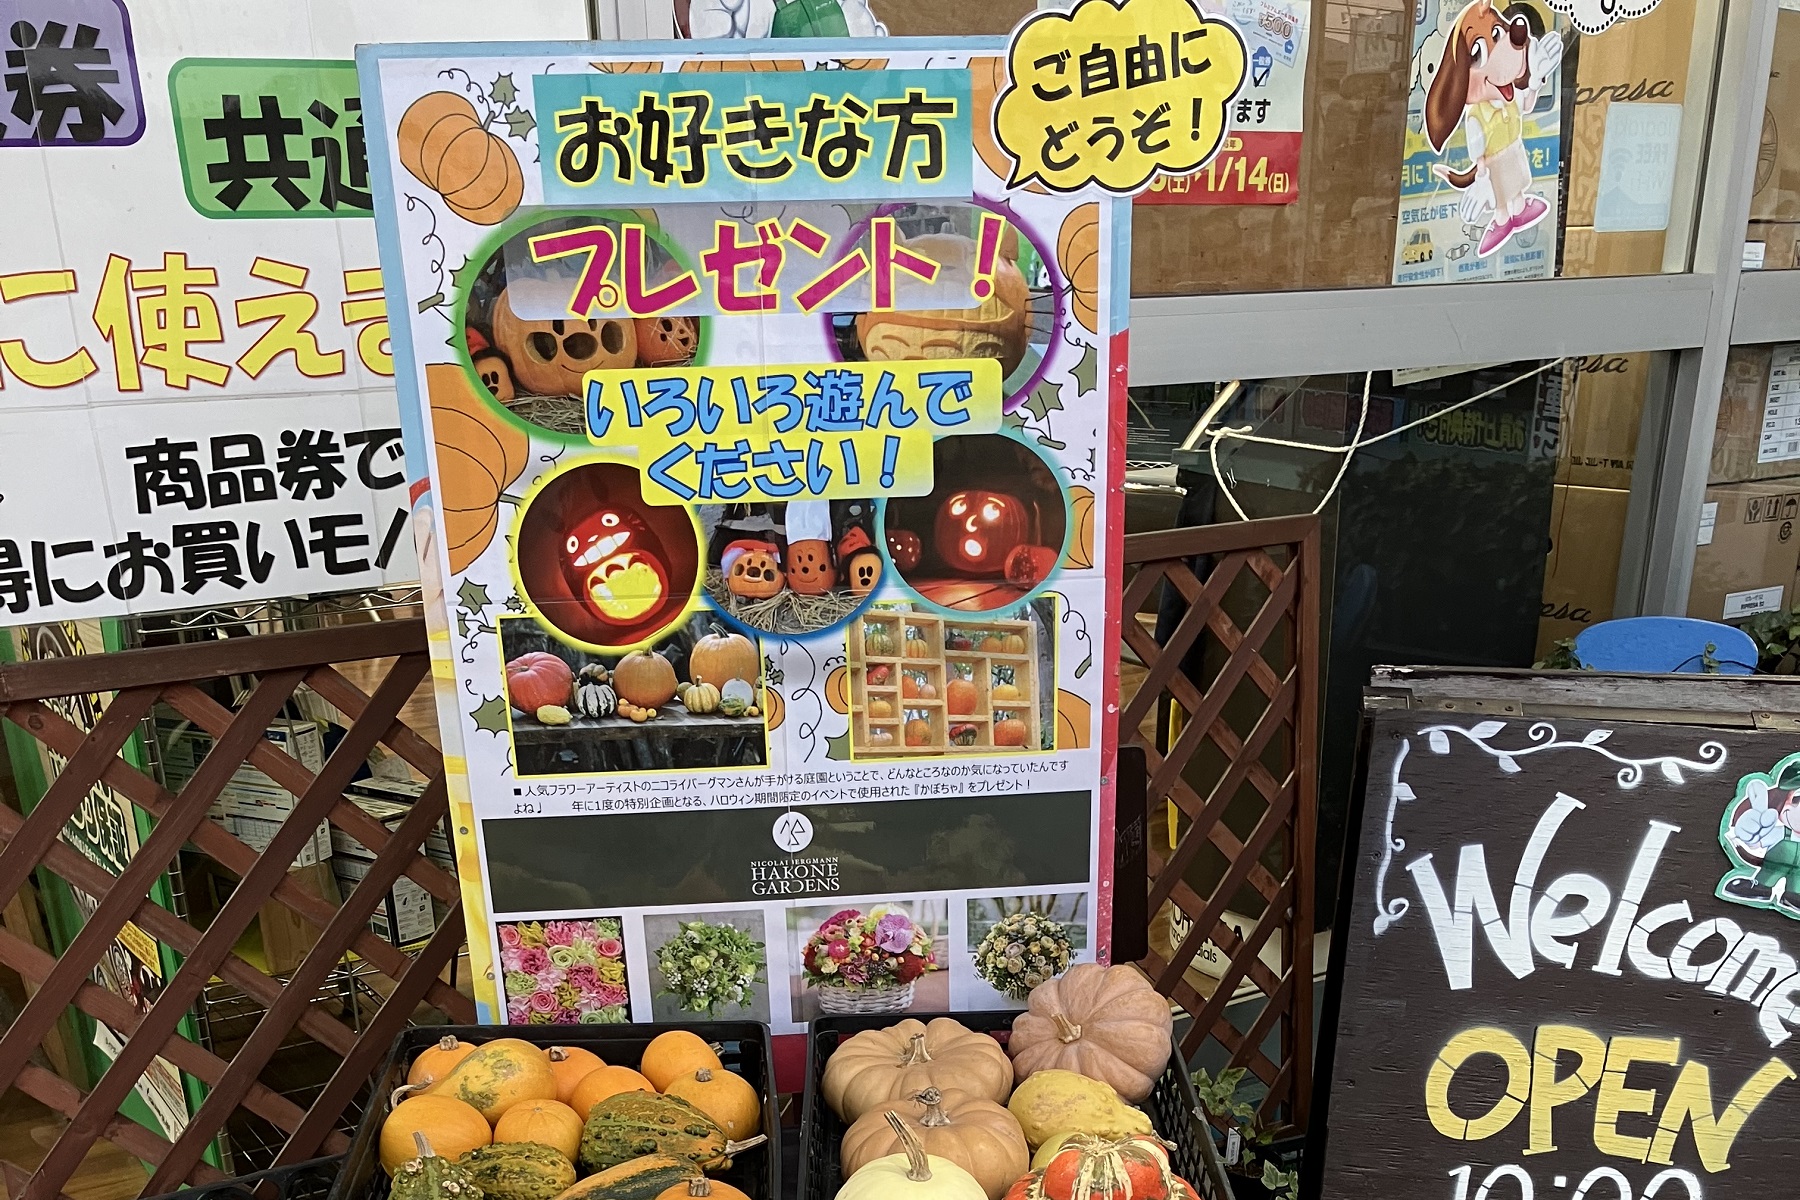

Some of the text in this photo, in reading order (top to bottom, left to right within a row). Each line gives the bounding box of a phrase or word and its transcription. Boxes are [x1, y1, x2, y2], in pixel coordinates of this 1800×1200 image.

[1032, 28, 1212, 102] ご自由に
[555, 89, 956, 187] お好きな方
[1041, 98, 1203, 172] どうぞ！
[527, 213, 1007, 320] プレゼント！
[586, 368, 976, 438] いろいろ遊んで
[125, 428, 407, 514] 商品券で
[643, 435, 904, 501] ください！
[751, 863, 840, 881] HAKONE
[751, 877, 840, 896] GARDENS
[1405, 791, 1800, 1048] Welcome
[1425, 1024, 1797, 1174] OPEN
